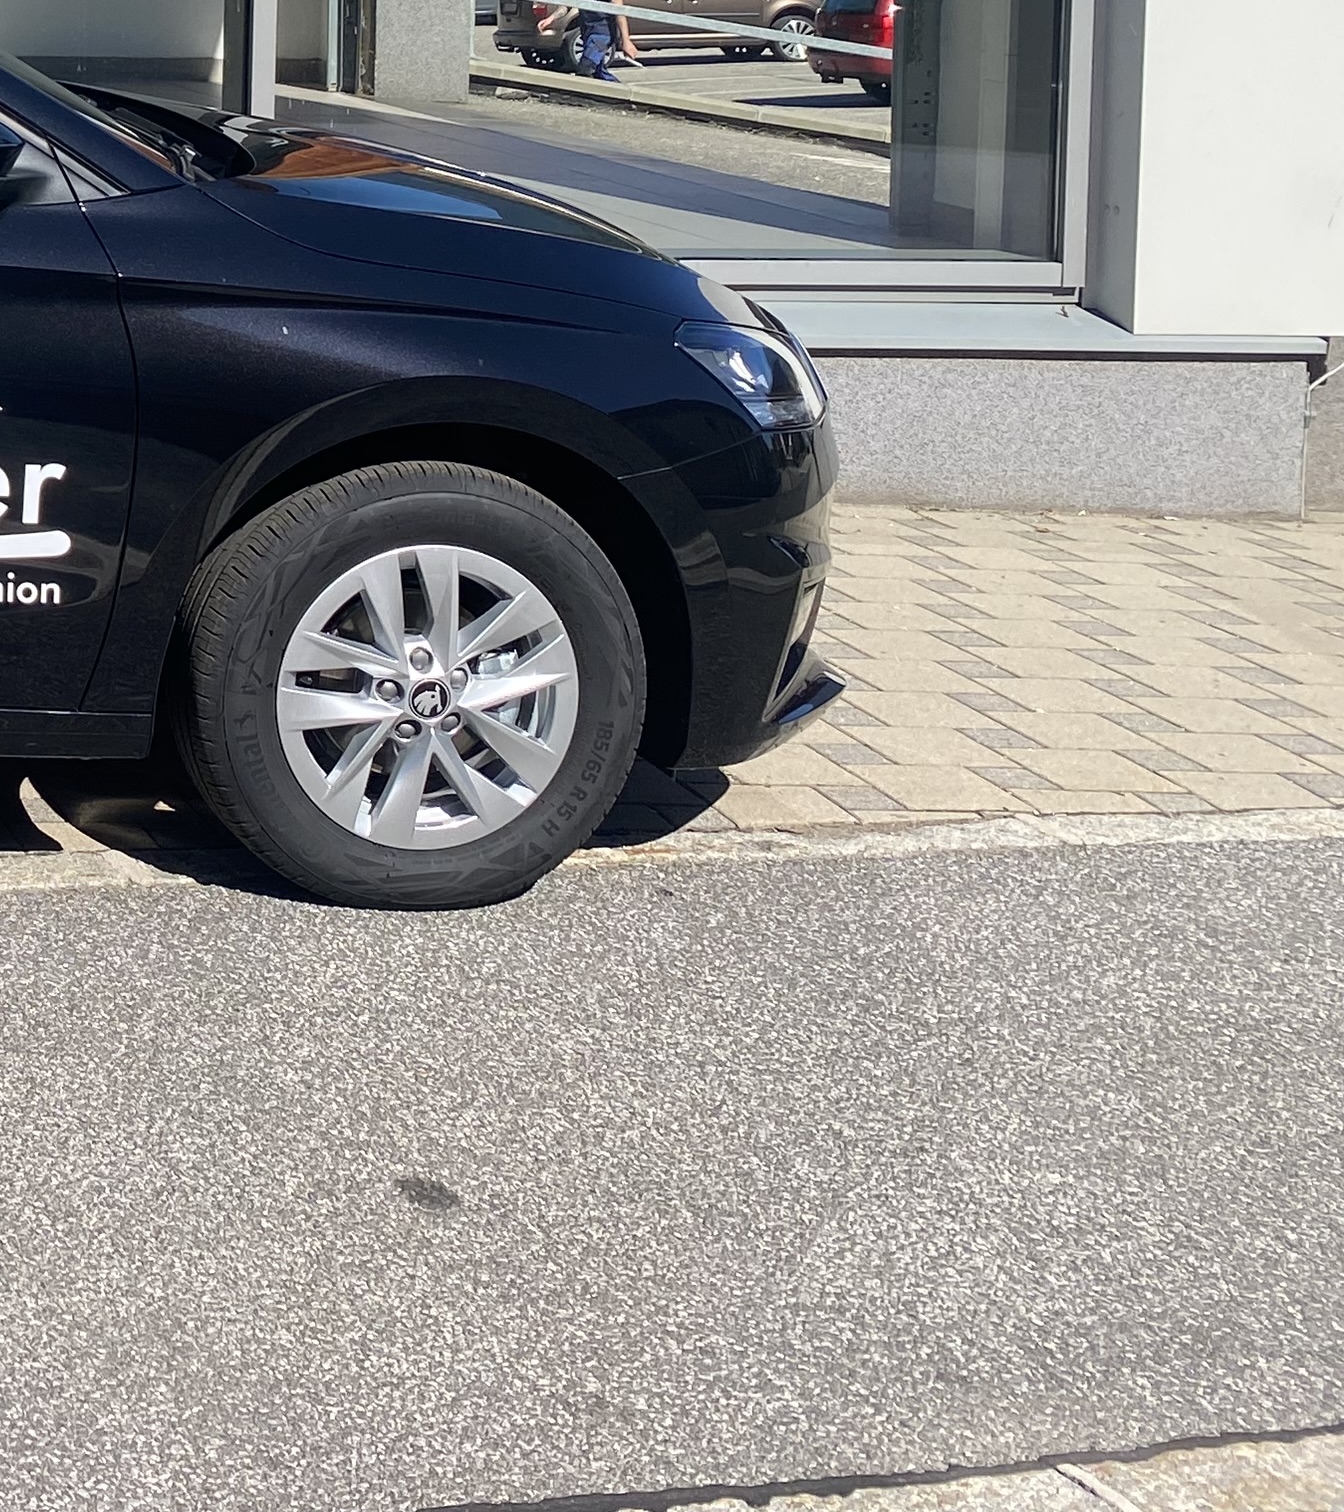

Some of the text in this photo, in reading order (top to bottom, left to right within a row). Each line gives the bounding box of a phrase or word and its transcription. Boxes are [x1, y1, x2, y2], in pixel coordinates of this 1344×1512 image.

[540, 720, 615, 838] 185/65 R 15 H
